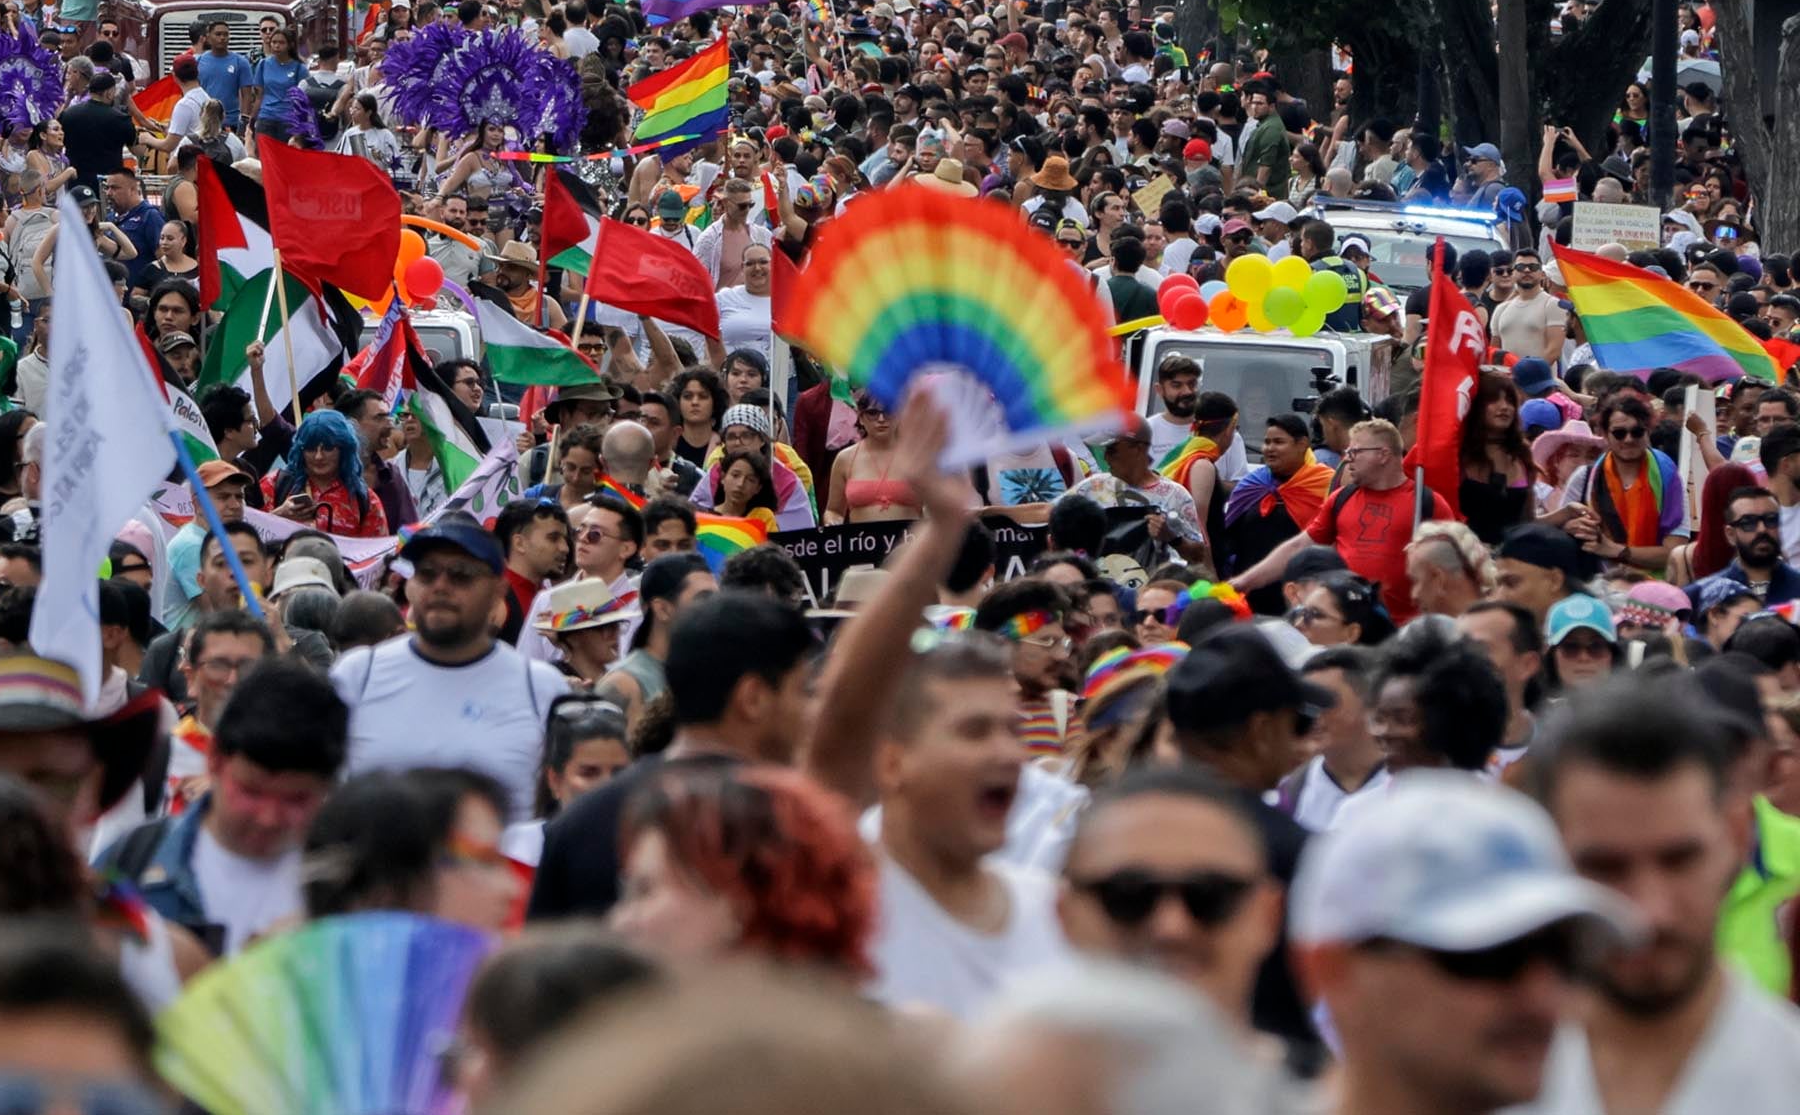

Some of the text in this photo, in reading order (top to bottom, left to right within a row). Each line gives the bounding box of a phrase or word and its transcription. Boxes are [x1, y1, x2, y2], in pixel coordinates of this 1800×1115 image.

[827, 533, 842, 555] el
[849, 530, 876, 552] río
[883, 534, 895, 554] y
